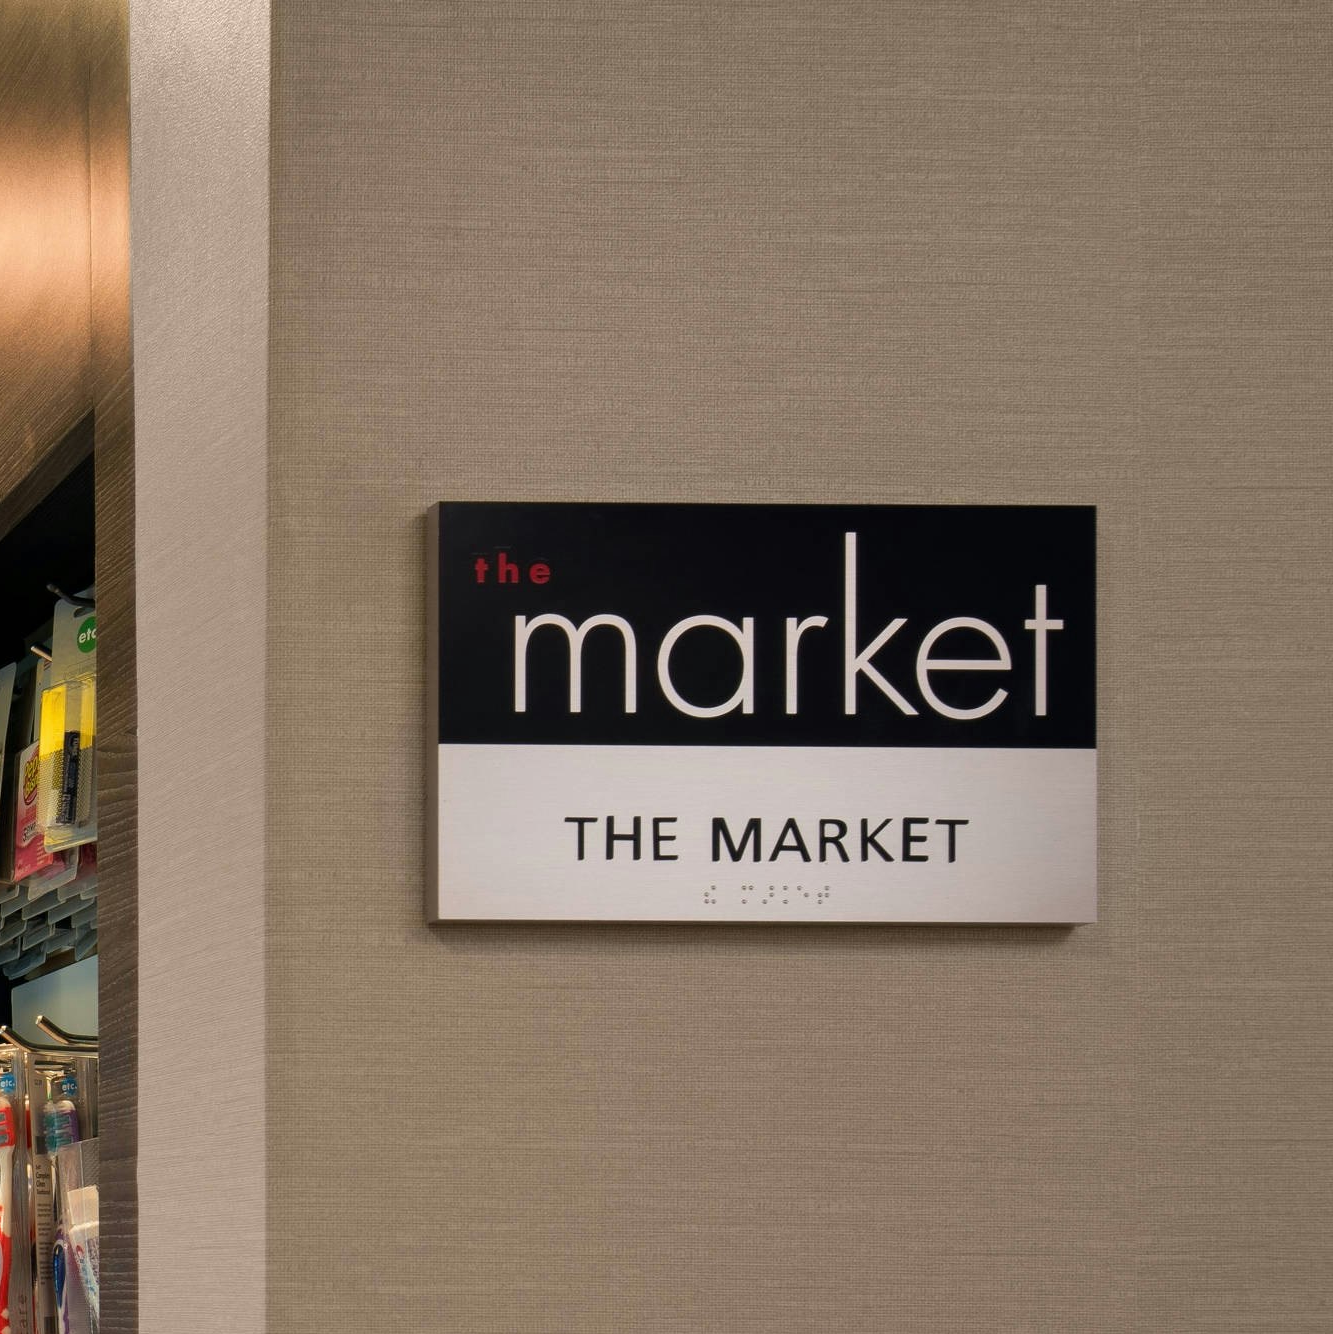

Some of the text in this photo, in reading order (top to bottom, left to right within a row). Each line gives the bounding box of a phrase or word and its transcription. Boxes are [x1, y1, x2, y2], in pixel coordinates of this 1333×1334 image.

[474, 551, 551, 585] the
[514, 531, 1064, 720] market
[564, 815, 970, 863] THE MARKET
